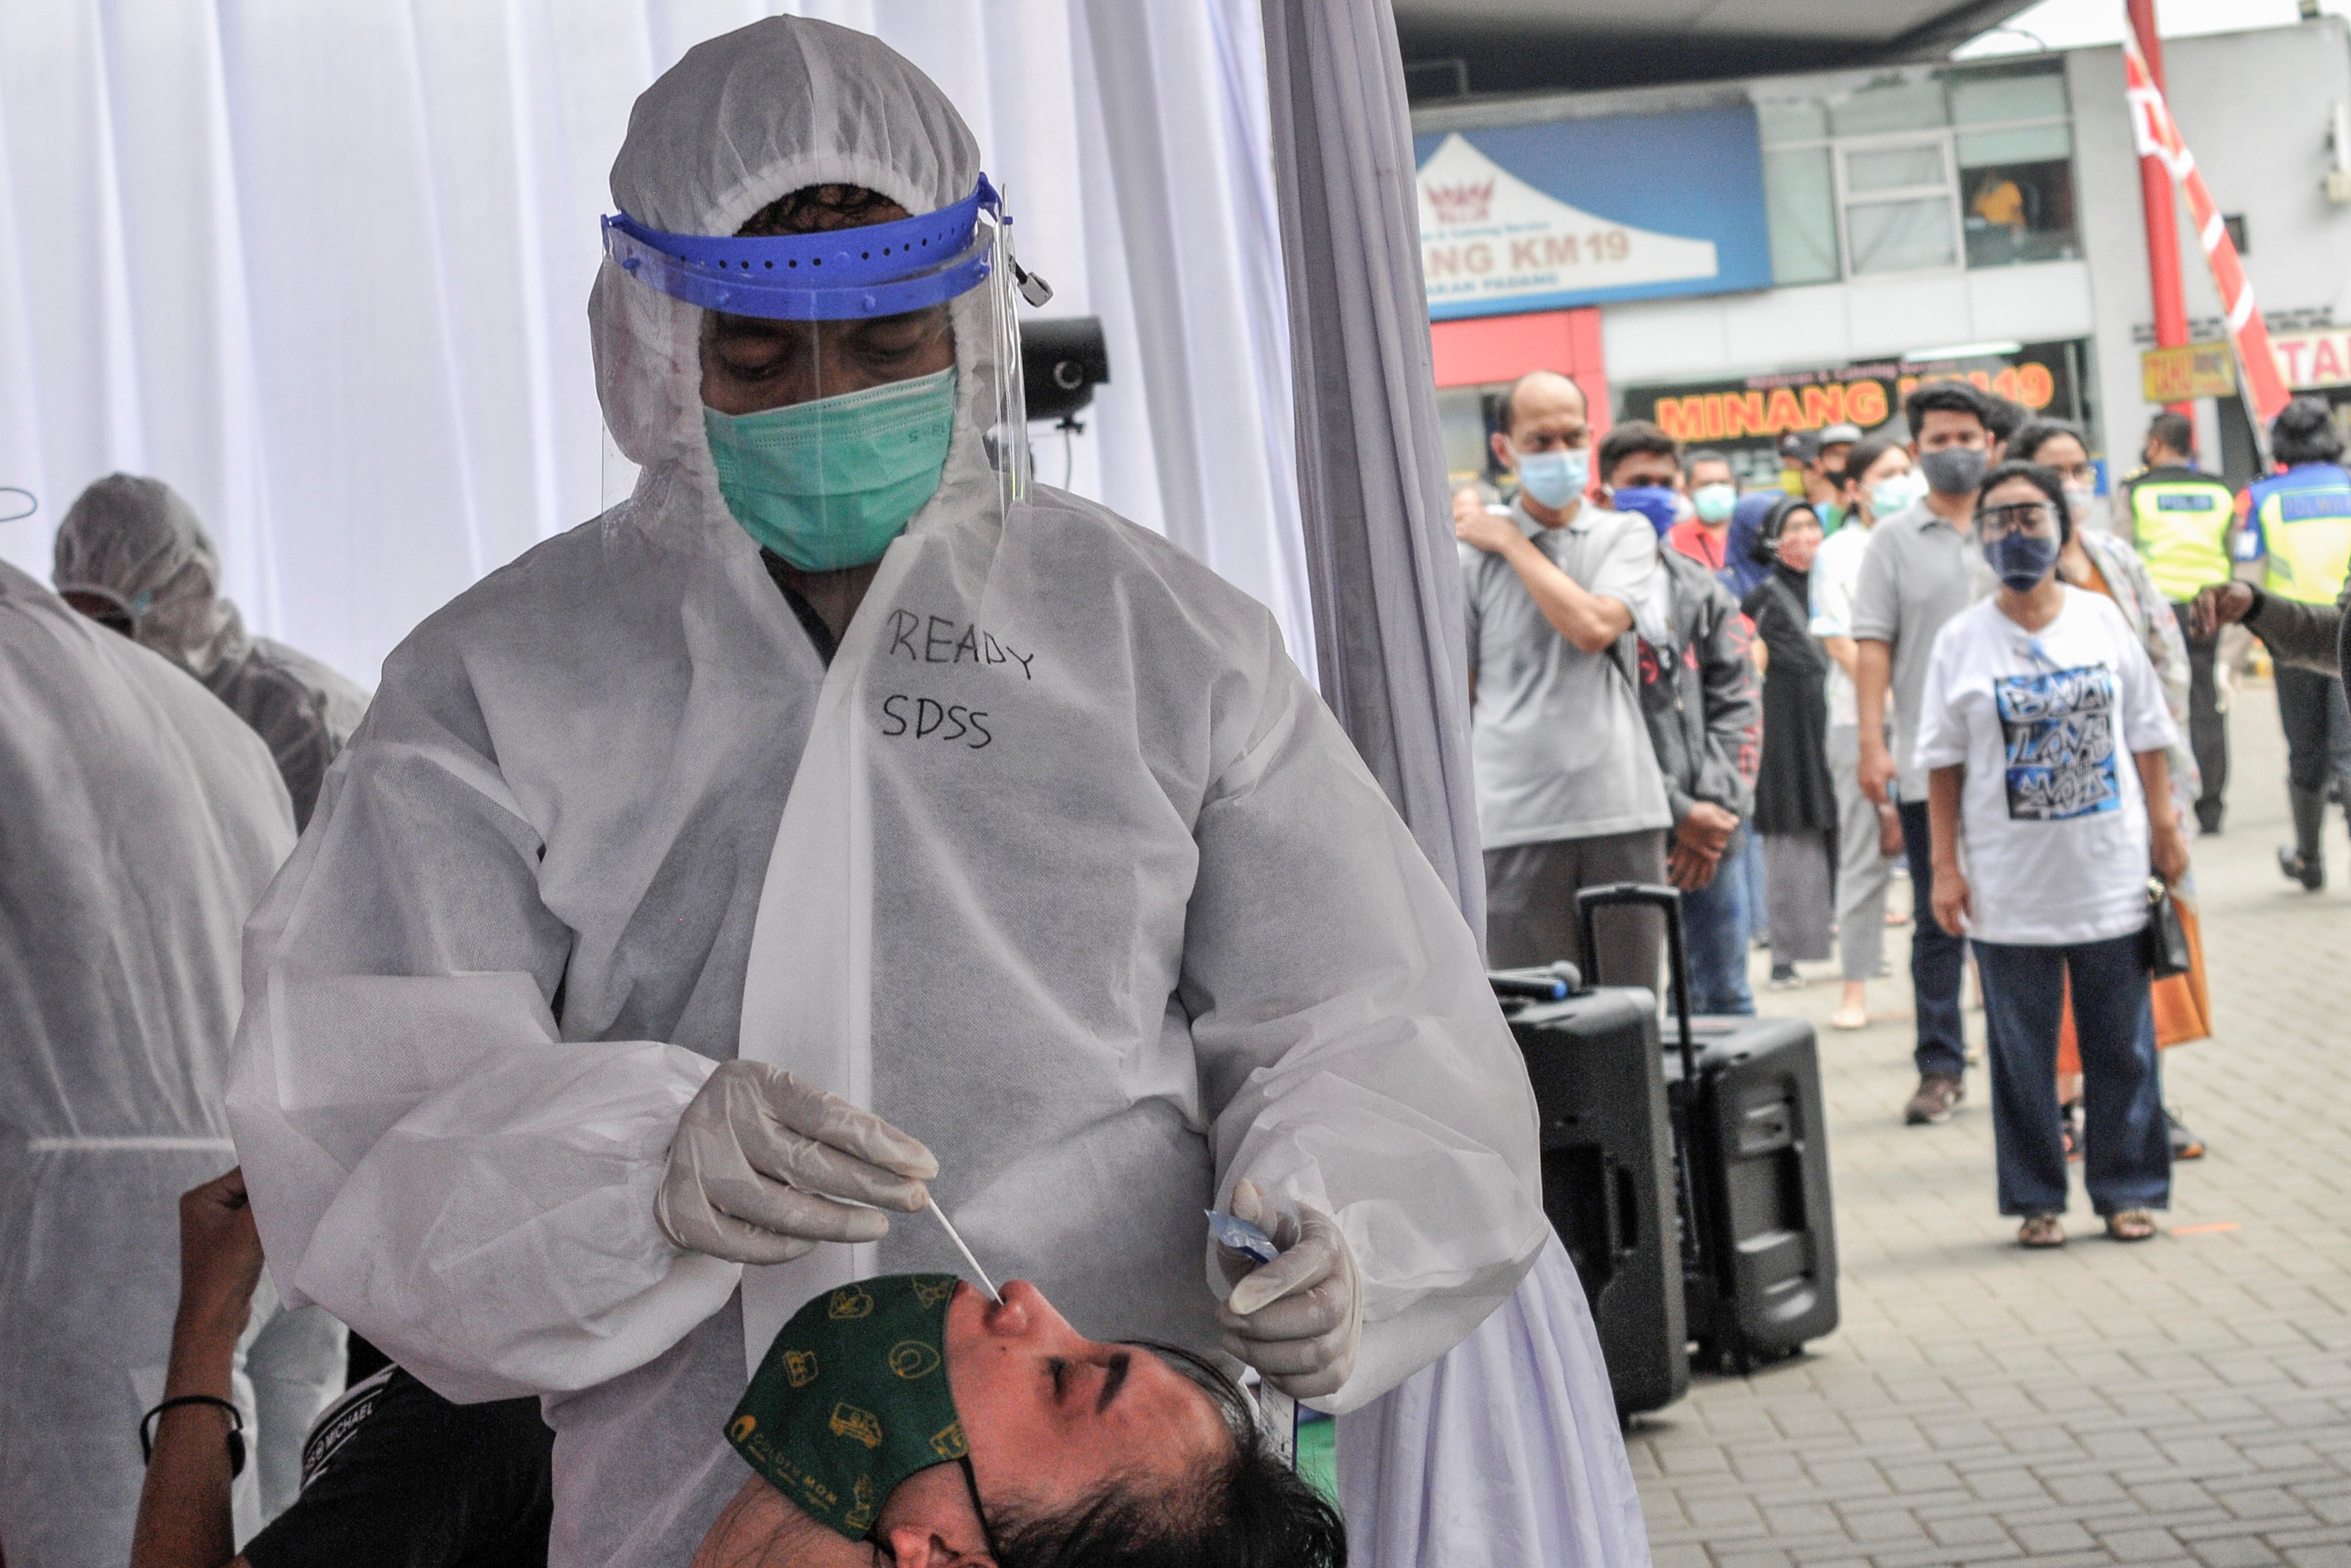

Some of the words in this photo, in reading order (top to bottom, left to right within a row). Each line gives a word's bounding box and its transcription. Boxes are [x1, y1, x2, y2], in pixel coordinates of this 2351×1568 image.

[1424, 243, 1494, 279] NG
[2278, 336, 2351, 382] TA
[1656, 379, 1887, 441] MINANG
[888, 610, 1033, 680] READY
[883, 695, 992, 749] SDSS
[325, 1401, 374, 1450] MICHAEL
[803, 1475, 838, 1505] MOM
